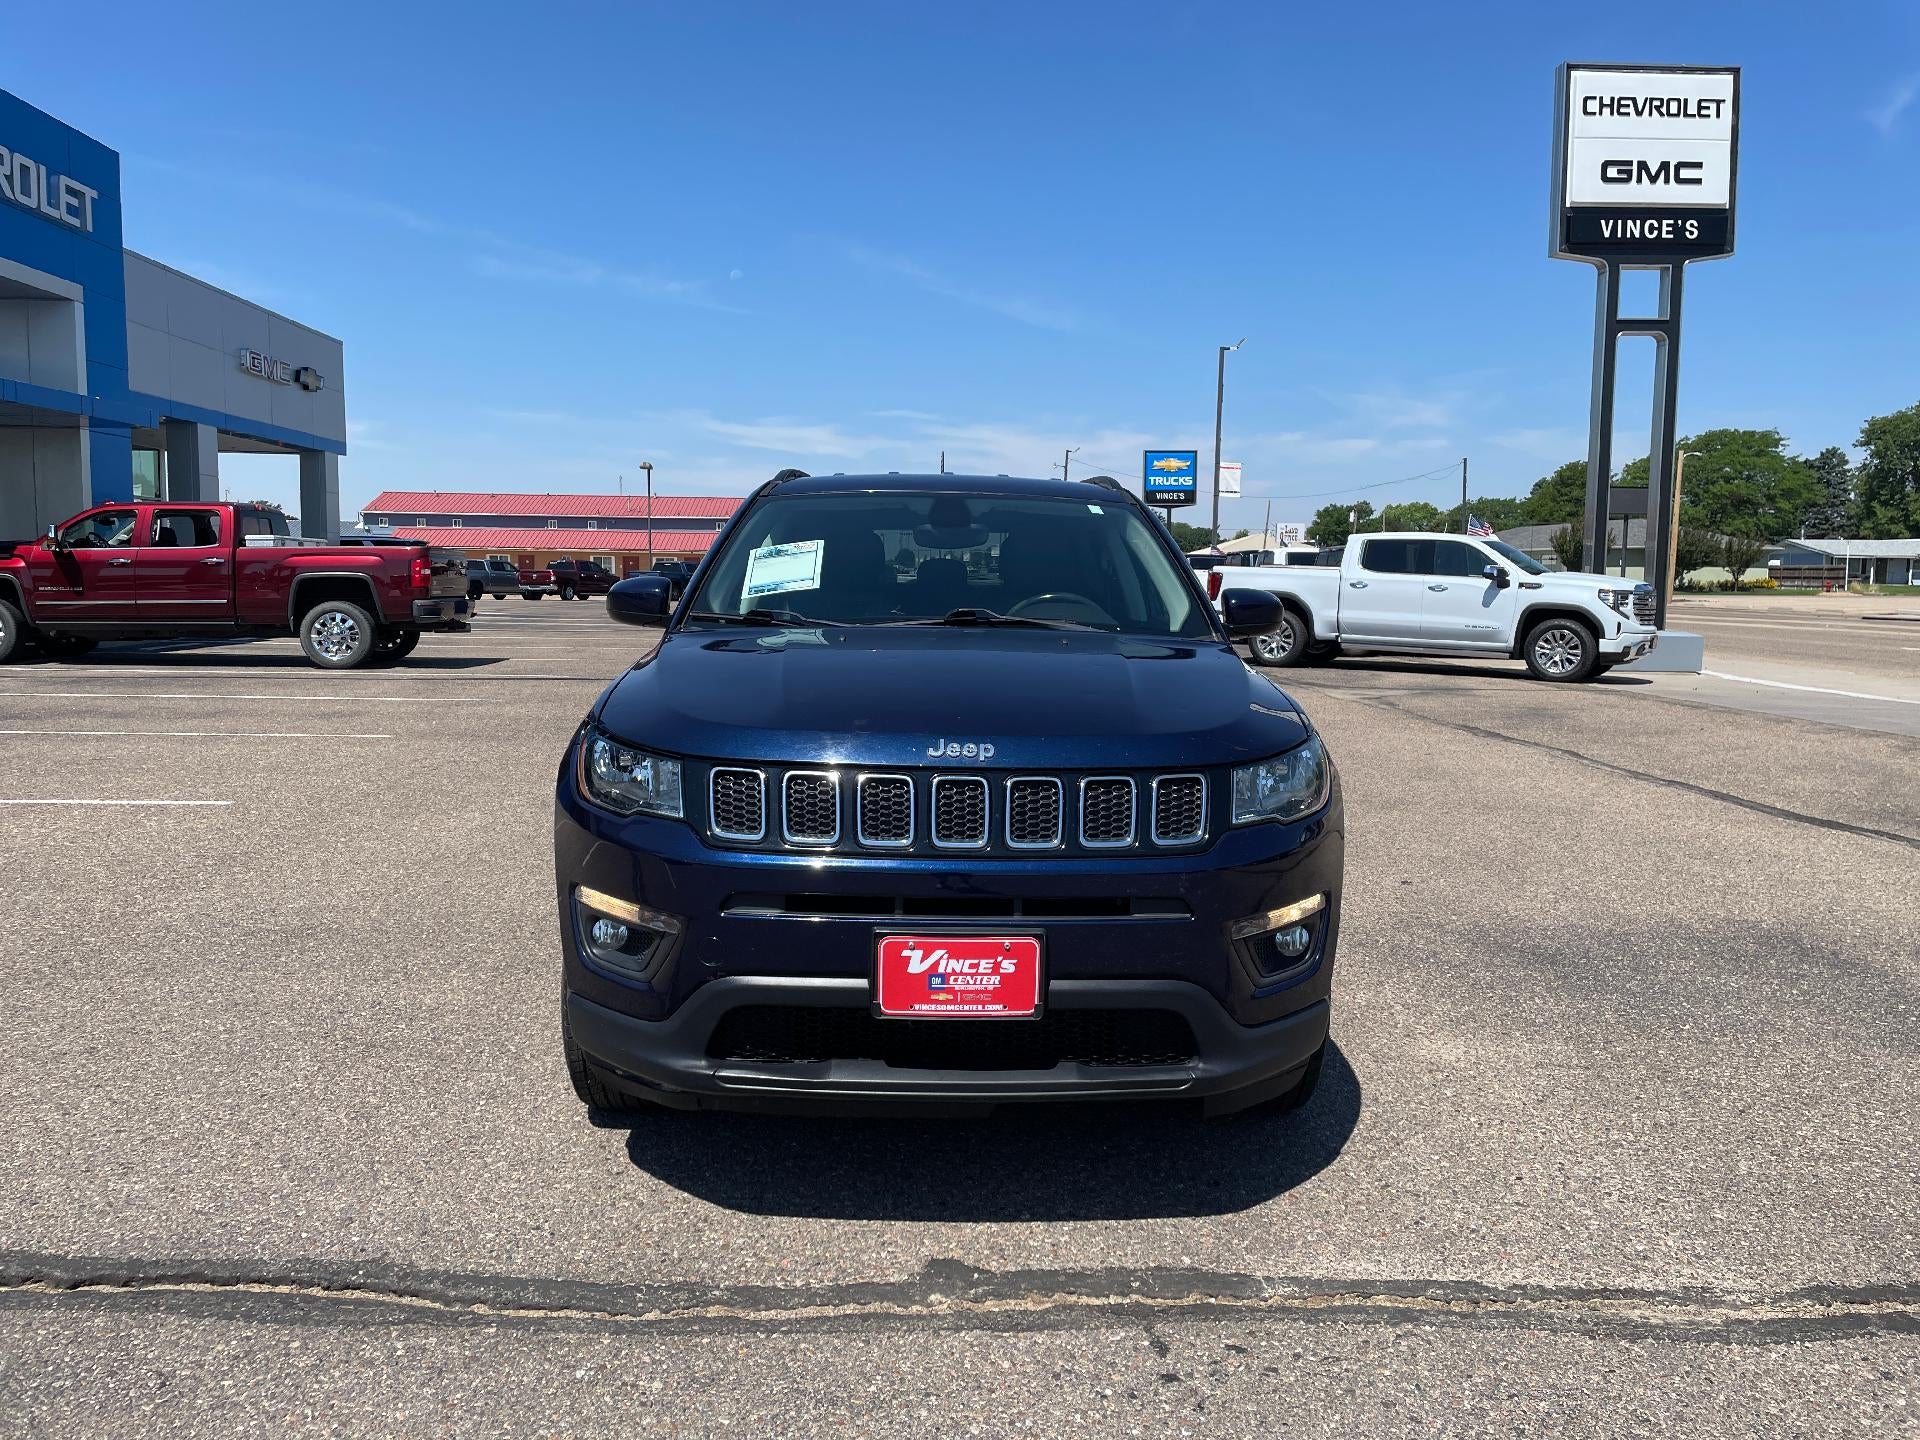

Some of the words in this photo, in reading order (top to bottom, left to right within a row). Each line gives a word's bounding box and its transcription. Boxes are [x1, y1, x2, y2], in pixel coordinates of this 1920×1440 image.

[1582, 95, 1726, 119] CHEVROLET
[1600, 159, 1703, 186] GMC
[1600, 219, 1699, 239] VINCE'S
[246, 349, 293, 386] GMC
[1148, 476, 1193, 486] TRUCKS
[1155, 492, 1185, 500] VINCE'S
[927, 738, 995, 762] Jeep
[900, 949, 1018, 975] VINCE'S
[949, 975, 1001, 985] CENTER
